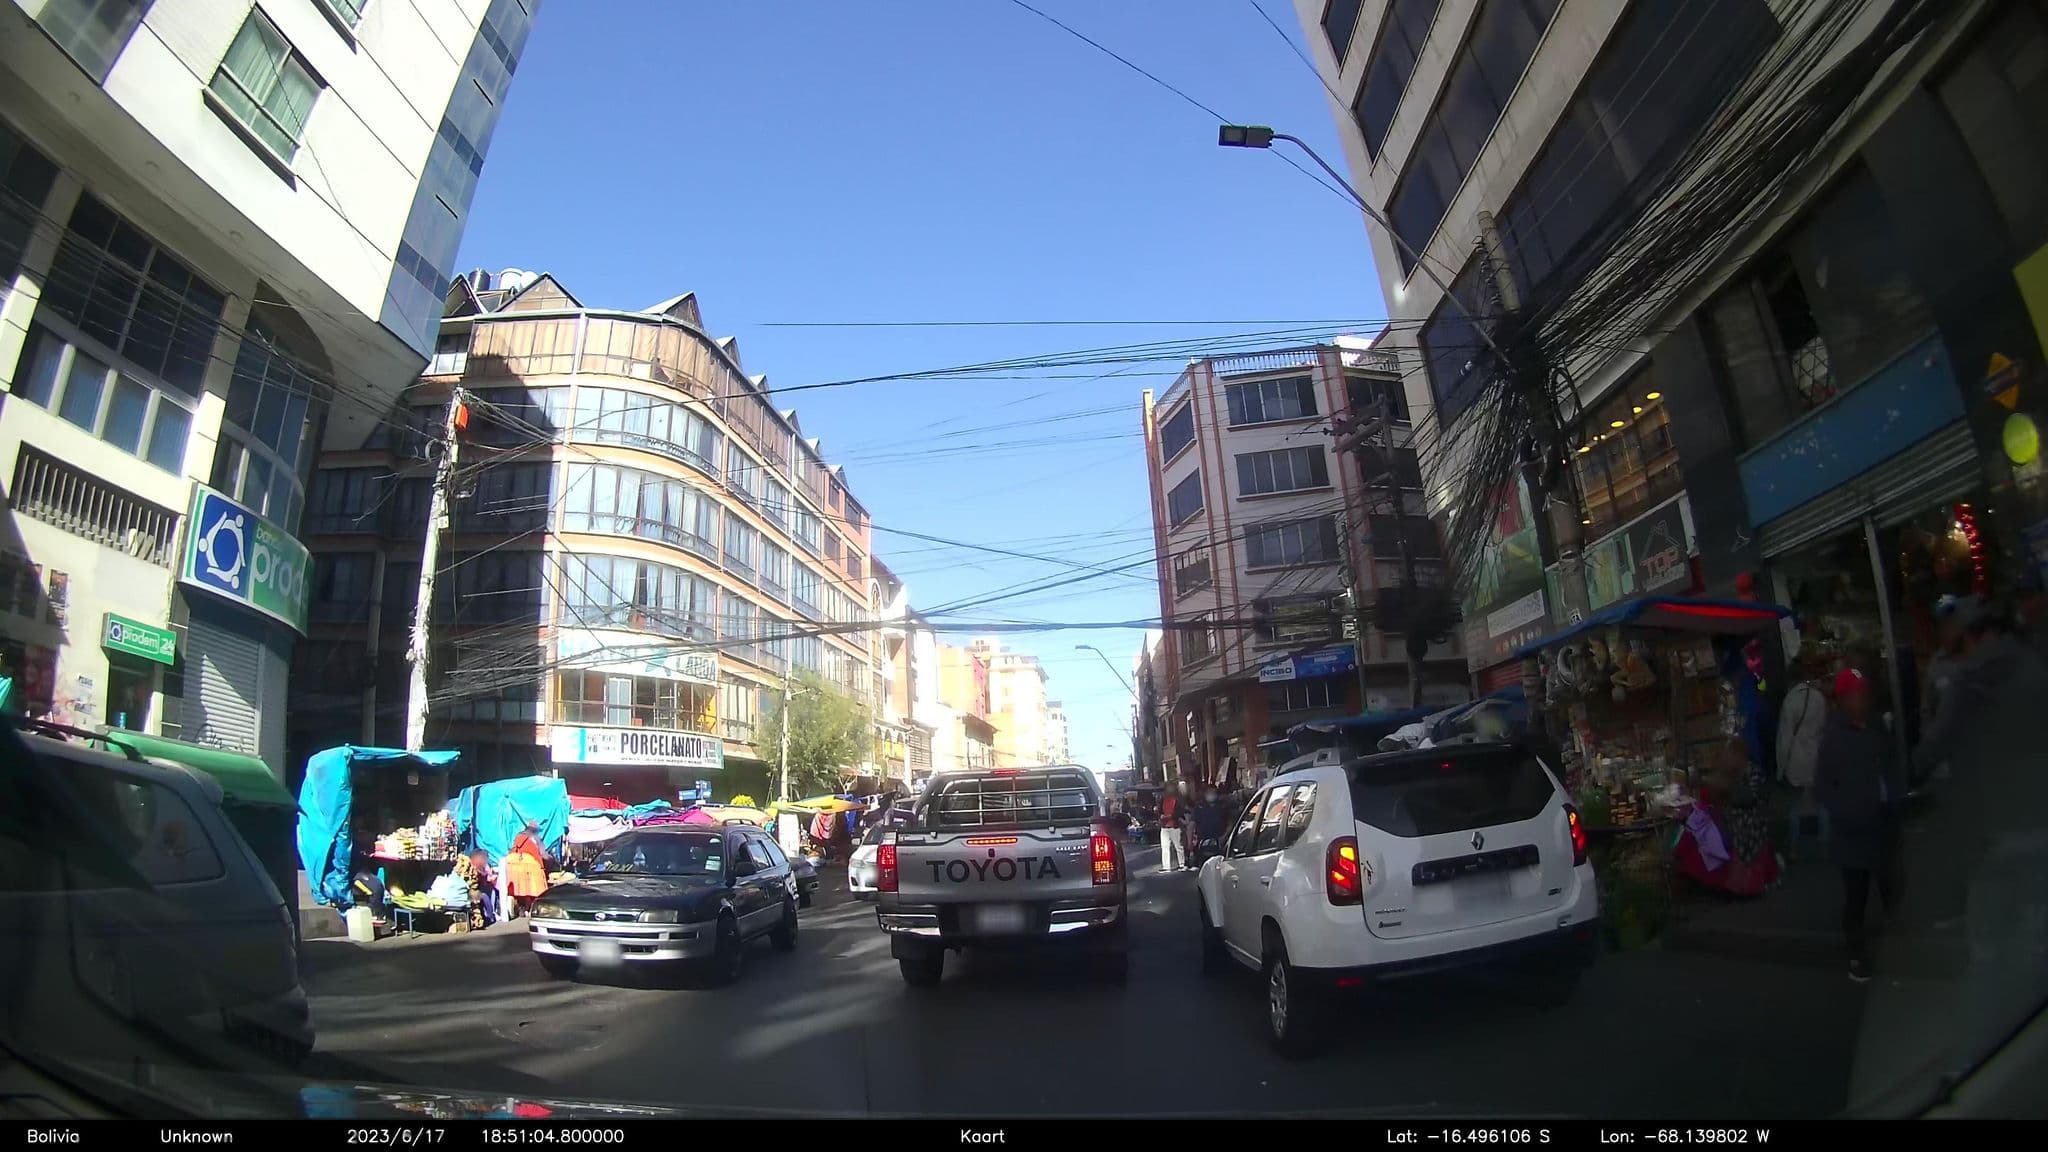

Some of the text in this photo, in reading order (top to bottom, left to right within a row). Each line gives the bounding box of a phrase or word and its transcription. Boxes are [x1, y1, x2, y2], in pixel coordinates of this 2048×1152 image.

[122, 629, 158, 650] prodem
[620, 732, 702, 759] PORCELANATO
[926, 856, 1061, 882] TOYOTA
